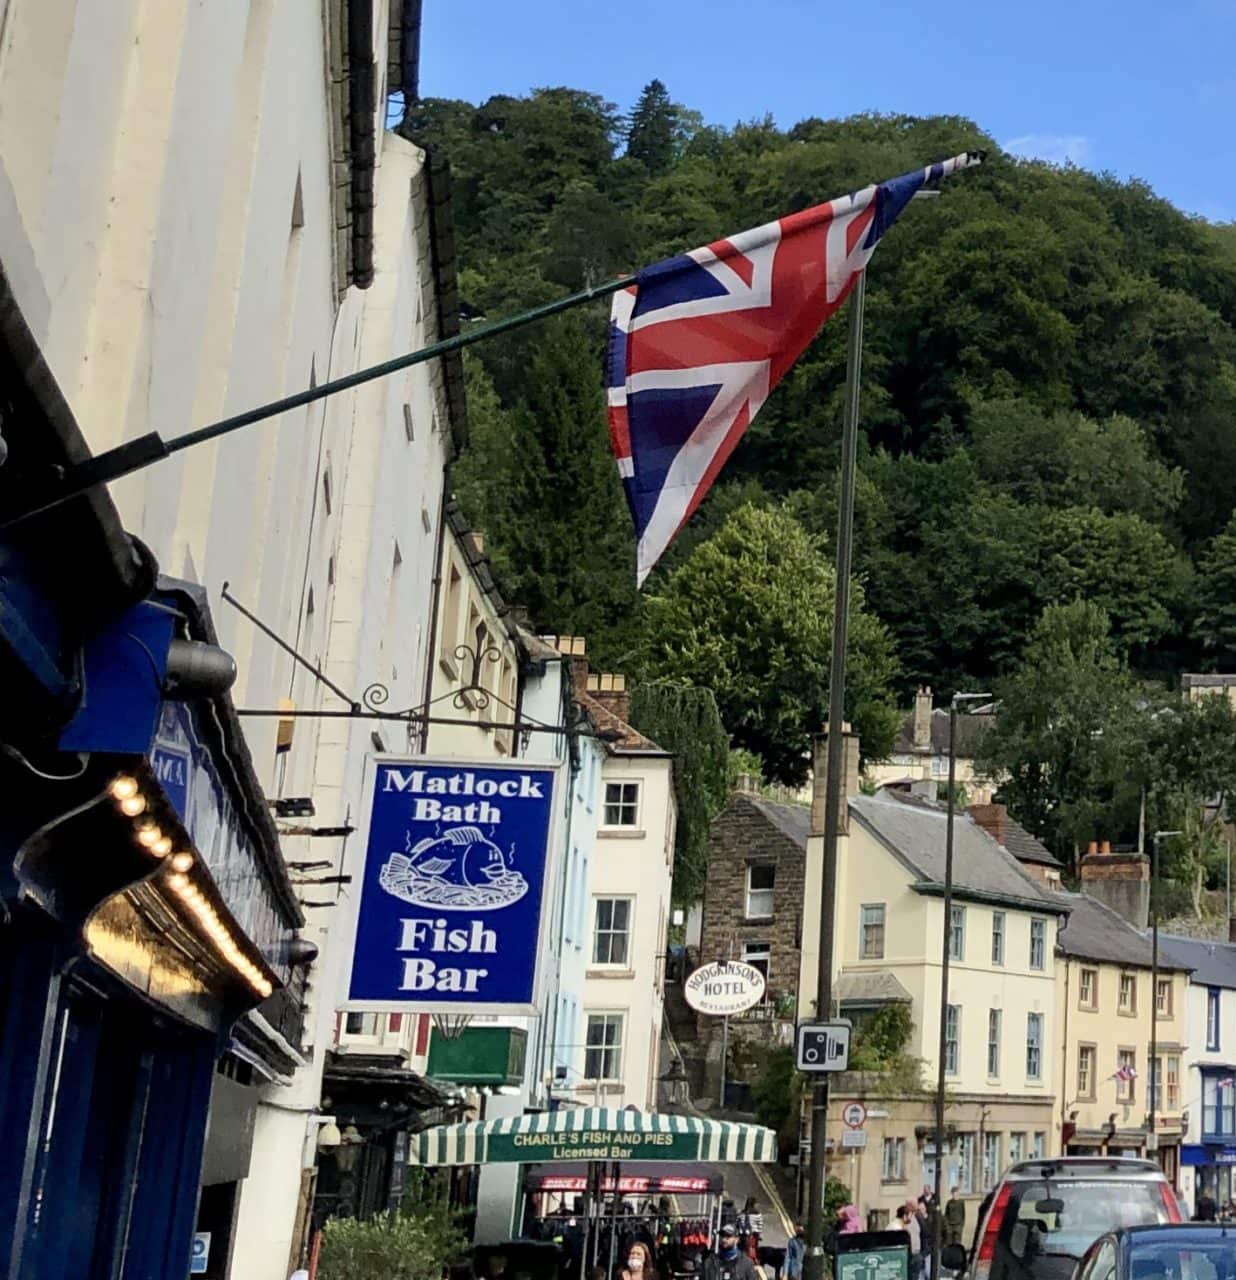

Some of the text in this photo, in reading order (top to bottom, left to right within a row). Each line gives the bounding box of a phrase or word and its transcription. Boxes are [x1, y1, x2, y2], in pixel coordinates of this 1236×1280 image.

[383, 770, 544, 798] Matlock
[412, 798, 500, 823] Bath
[395, 918, 497, 953] Fish
[398, 958, 488, 992] Bar
[704, 982, 746, 996] HOTEL
[582, 1131, 611, 1145] FISH
[614, 1132, 642, 1145] AND
[645, 1132, 674, 1146] PIES
[553, 1146, 633, 1159] Licensed Bar
